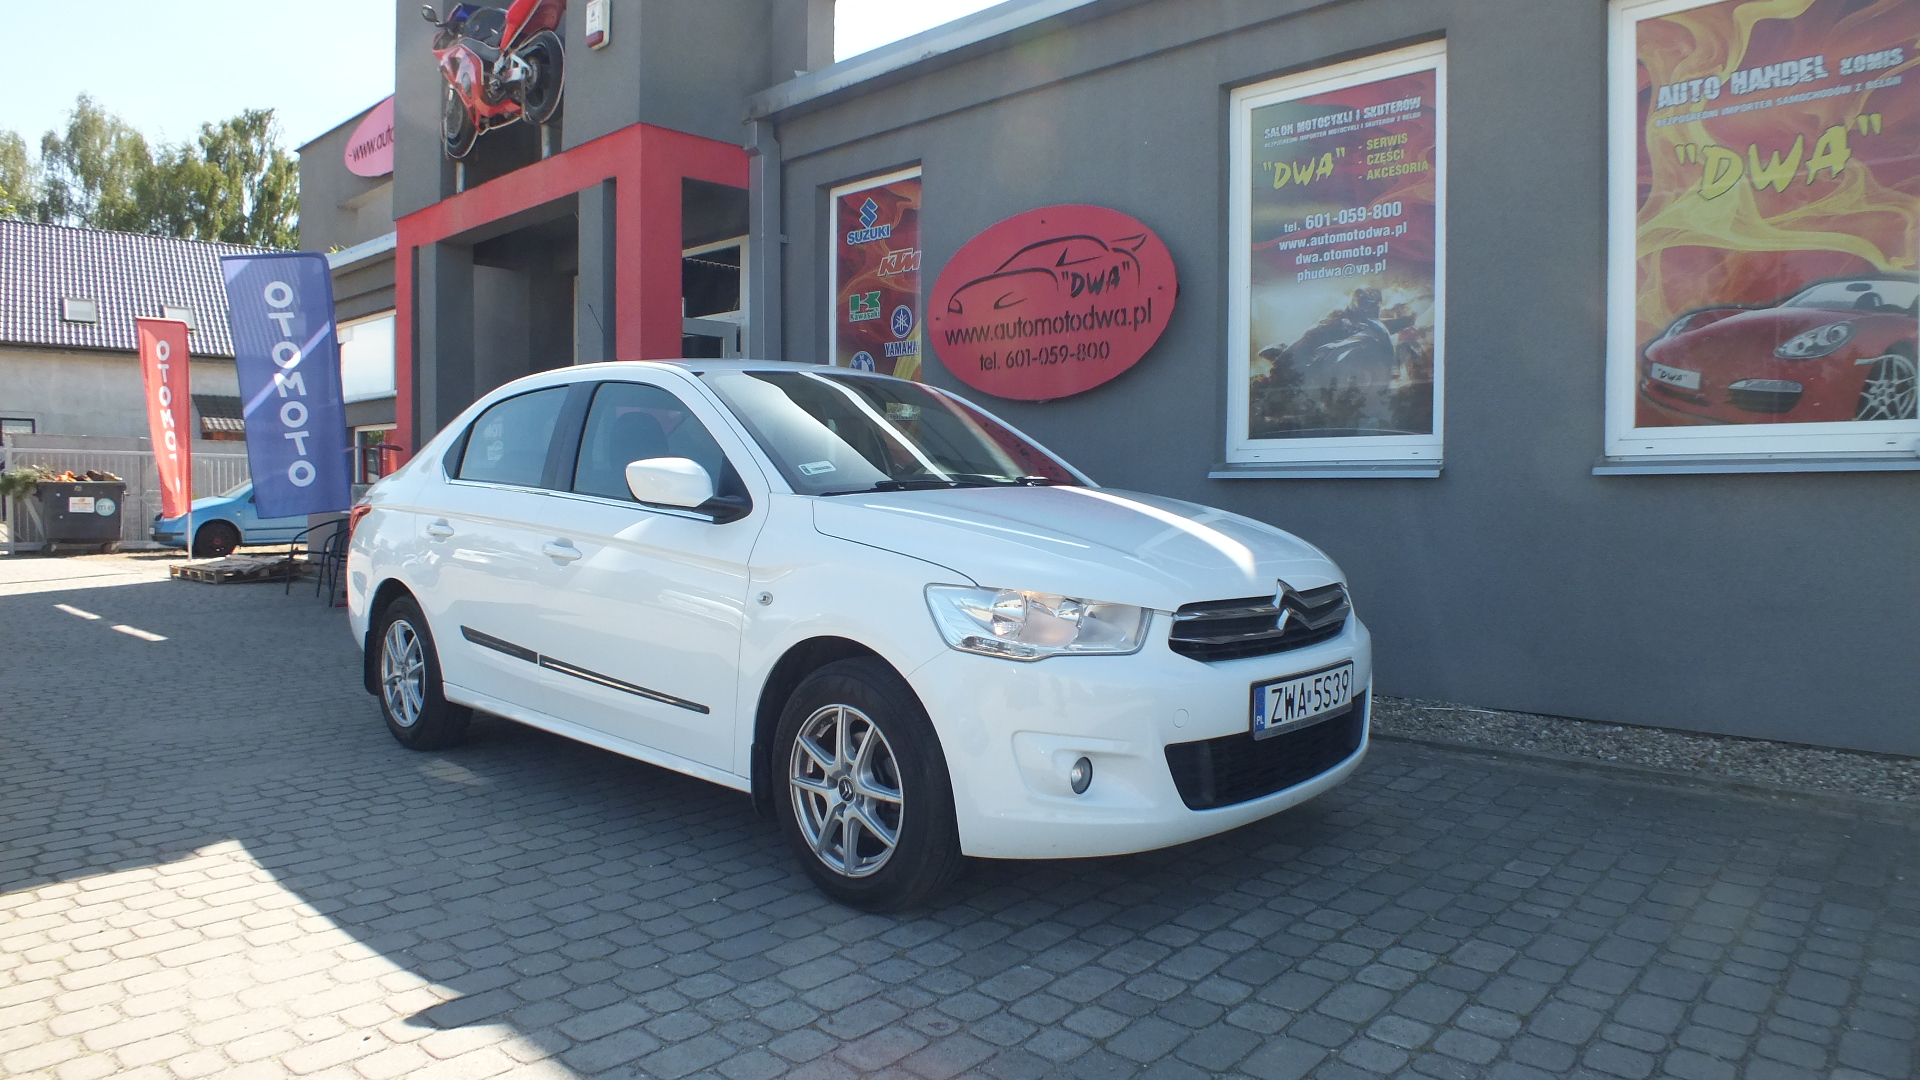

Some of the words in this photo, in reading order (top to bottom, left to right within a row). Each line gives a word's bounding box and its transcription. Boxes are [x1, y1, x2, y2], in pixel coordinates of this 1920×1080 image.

[1656, 75, 1721, 111] AUTO
[1730, 55, 1829, 95] HANDEL
[1839, 47, 1904, 76] KOMIS
[1264, 123, 1294, 139] SALON
[1296, 111, 1353, 133] MOTOCYKLI
[1355, 109, 1360, 121] I
[1363, 94, 1421, 119] SKUTERÓW
[1366, 132, 1408, 150] SERWIS
[1366, 148, 1405, 166] CZĘŚCI
[1366, 160, 1429, 181] AKCESORIA
[1284, 222, 1301, 233] tel.
[1305, 201, 1402, 230] 601-059-800
[847, 224, 891, 246] SUZUKI
[1279, 221, 1407, 251] www.automotodwa.pl
[877, 248, 922, 277] KTM
[1295, 242, 1389, 265] dwa.otomoto.pl
[1297, 259, 1386, 284] phudwa@vp.pl
[850, 308, 881, 322] Kawasaki
[945, 297, 1152, 346] www.automotodwa.pl
[884, 340, 919, 358] YAMAHA
[979, 352, 1001, 371] tel.
[1005, 340, 1110, 369] 601-059-800
[264, 281, 316, 487] OTOMOTO
[156, 340, 181, 493] OTOMO
[1270, 681, 1307, 724] ZWA
[1313, 669, 1349, 712] 5S39
[1256, 715, 1264, 726] PL
